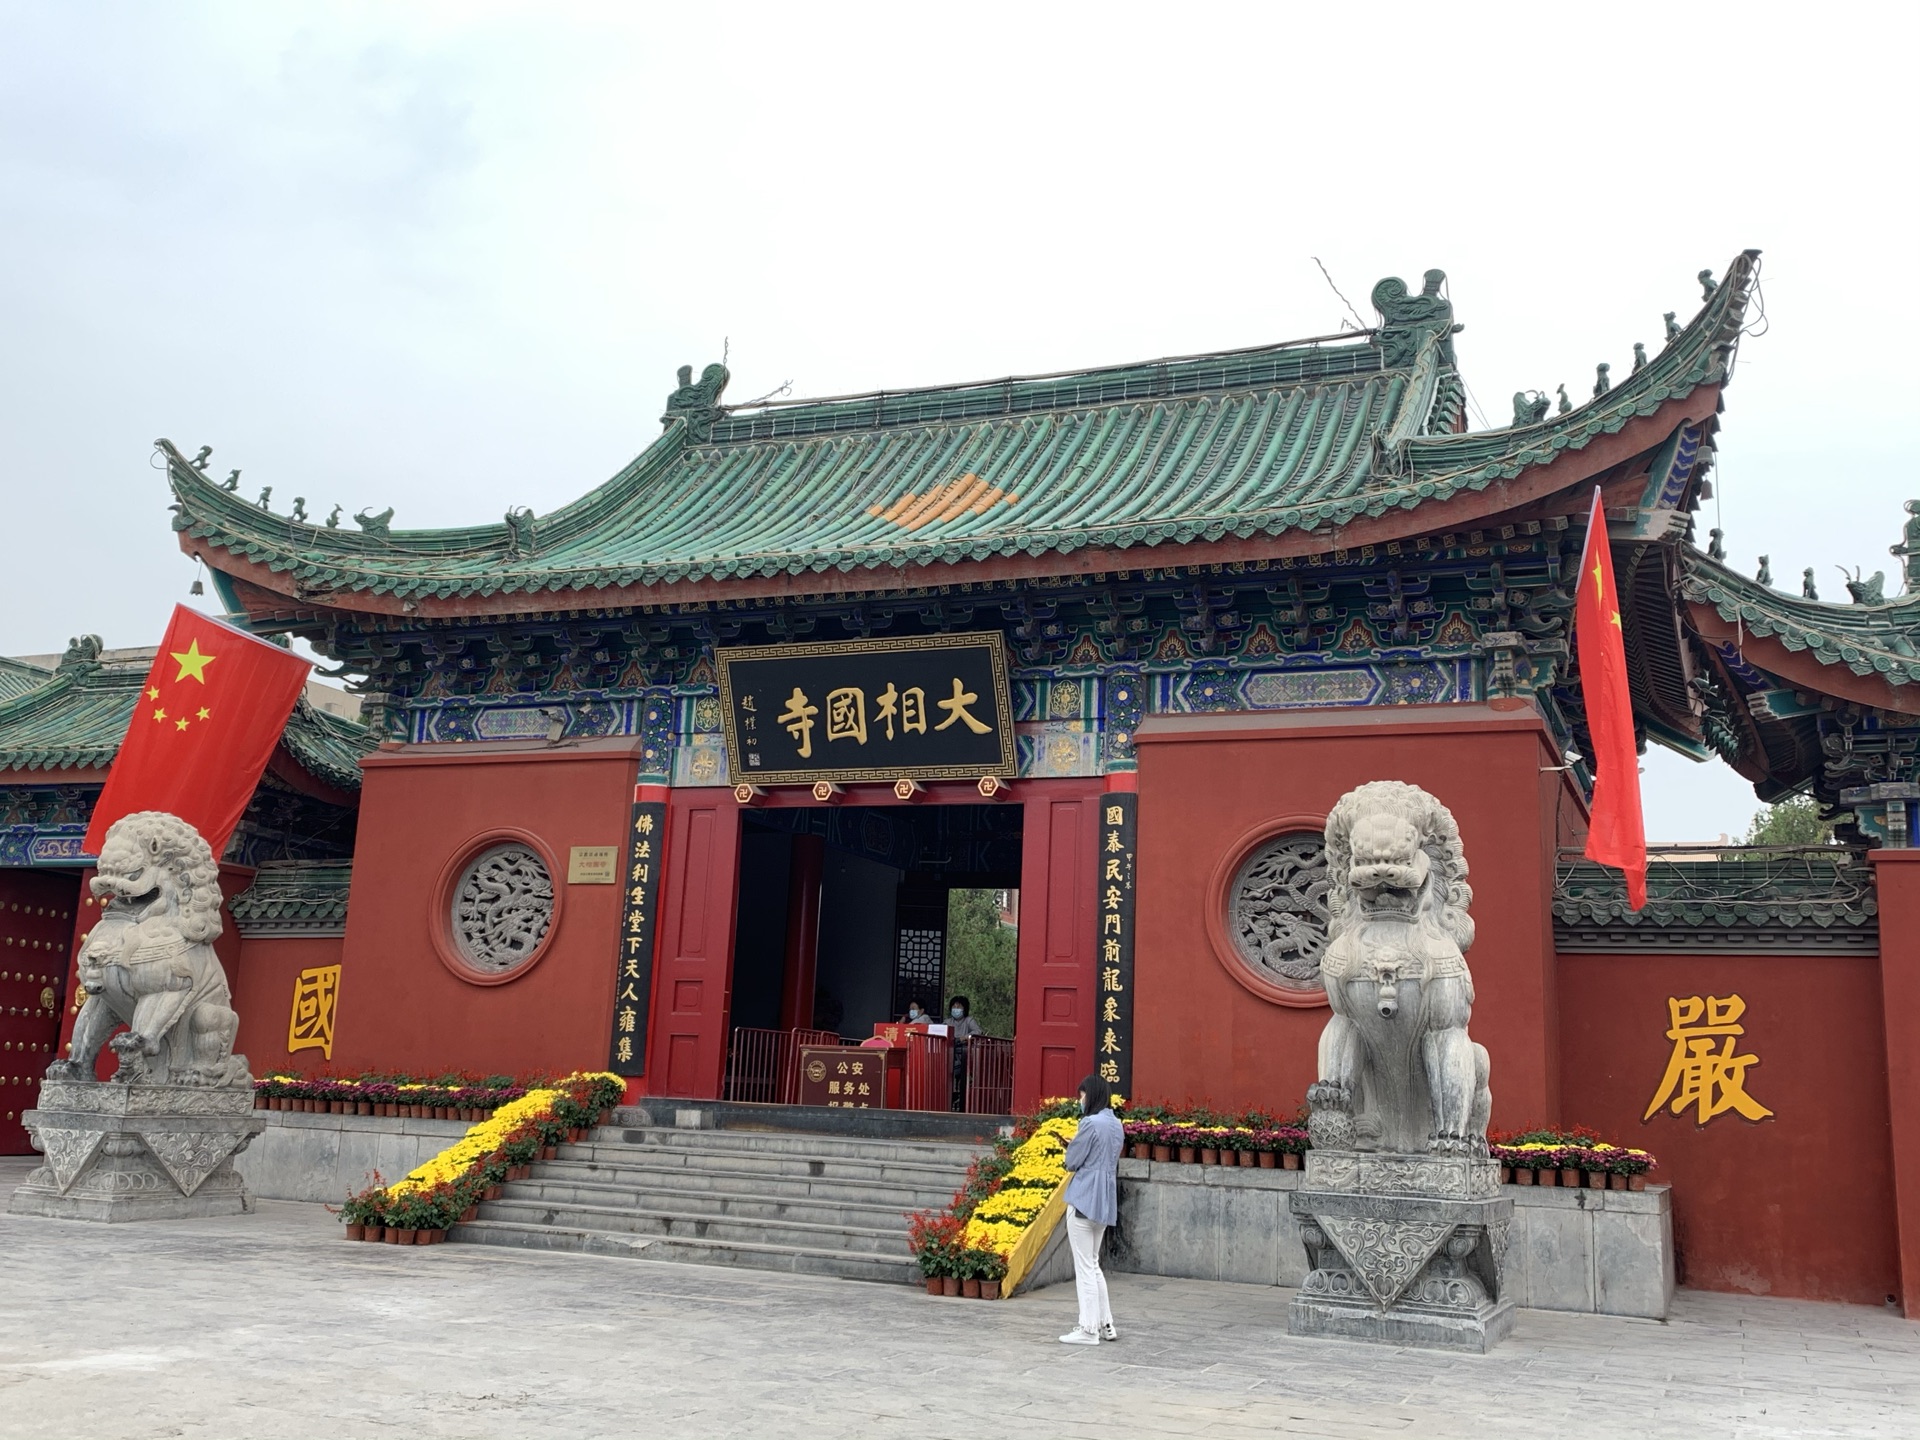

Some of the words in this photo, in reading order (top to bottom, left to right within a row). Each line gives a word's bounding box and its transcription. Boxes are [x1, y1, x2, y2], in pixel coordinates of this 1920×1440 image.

[776, 677, 994, 758] 大相國寺
[287, 964, 342, 1060] 國
[828, 1081, 870, 1096] 服务处
[836, 1061, 864, 1075] 公安
[1643, 993, 1775, 1125] 嚴
